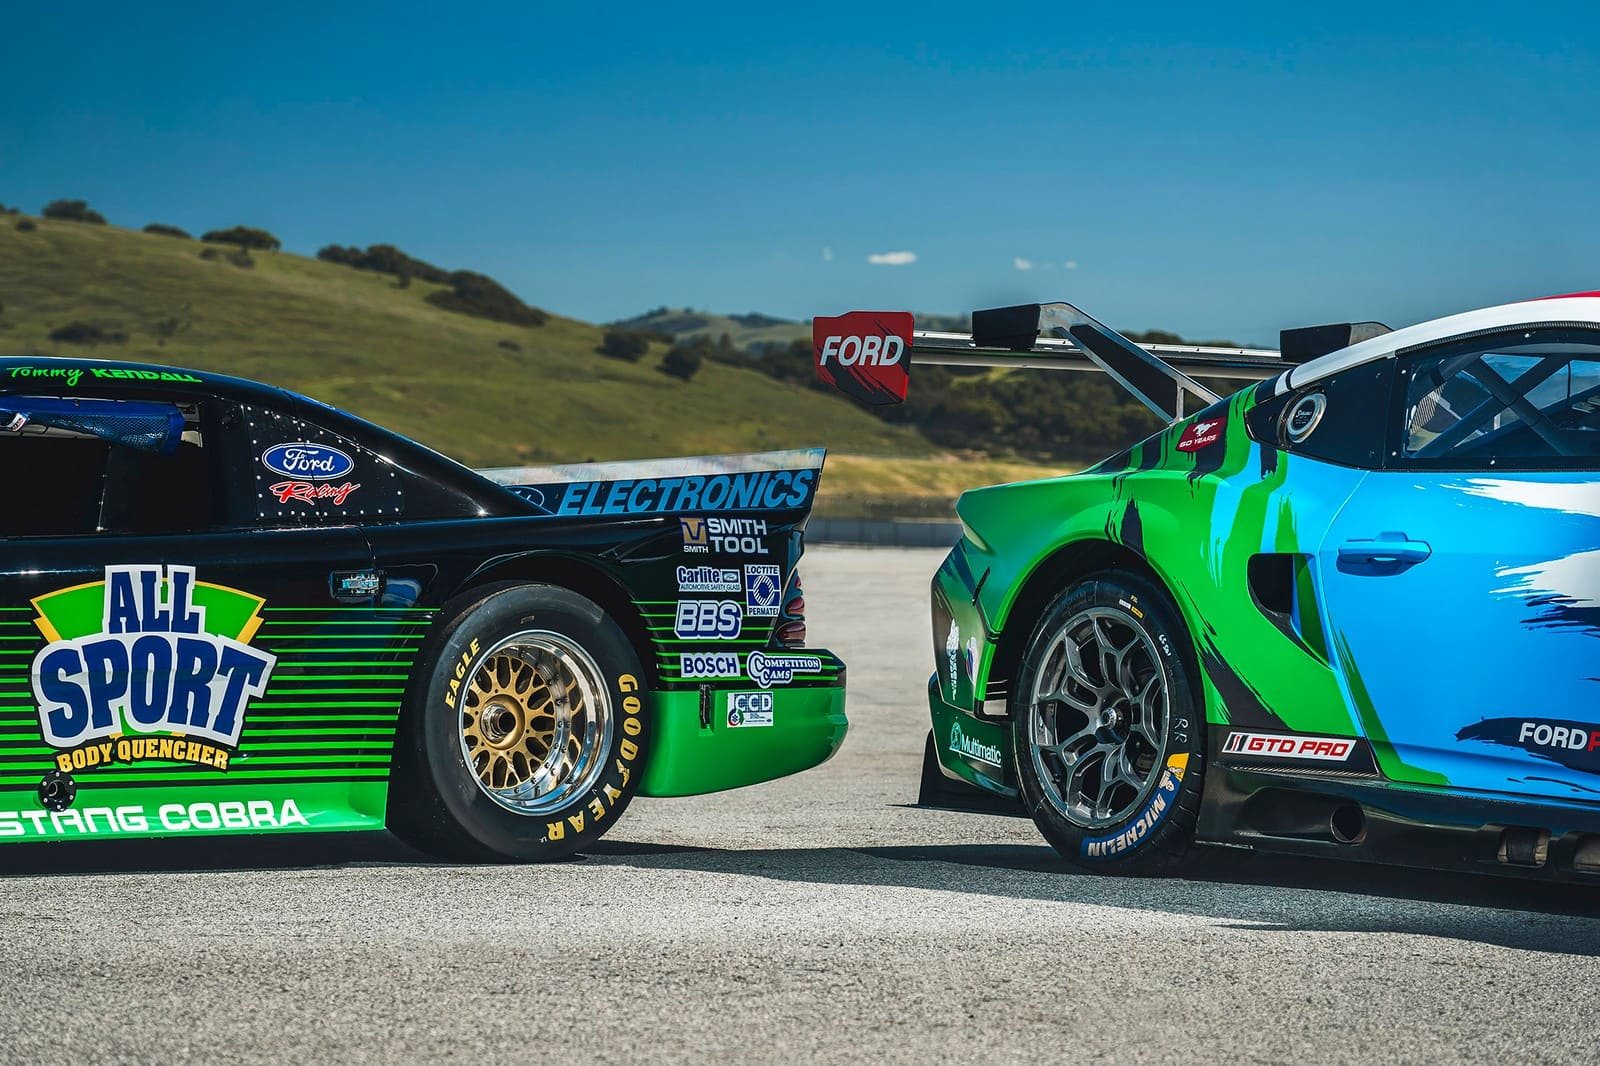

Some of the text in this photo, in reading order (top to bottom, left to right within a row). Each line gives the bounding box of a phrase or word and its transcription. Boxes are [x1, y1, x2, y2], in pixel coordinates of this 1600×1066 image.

[819, 335, 905, 367] FORD
[6, 366, 203, 387] Tommy KENDALL
[1179, 434, 1217, 448] 60 YEARS
[282, 447, 336, 472] Ford
[269, 481, 361, 506] Racing
[556, 469, 814, 516] ELECTRONICS
[707, 518, 768, 536] SMITH
[683, 545, 709, 553] SMITH
[709, 536, 769, 554] TOOL
[677, 566, 720, 583] Carlite
[746, 565, 778, 575] LOCTITE
[106, 568, 203, 637] ALL
[676, 601, 740, 636] BBS
[444, 637, 481, 710] EAGLE
[683, 656, 738, 674] BOSCH
[748, 652, 820, 679] COMPETITION
[37, 632, 270, 742] SPORT
[762, 669, 791, 687] CAMS
[735, 693, 772, 712] CCD
[57, 738, 229, 773] BODY QUENCHER
[961, 733, 1002, 763] Multimatic
[1247, 737, 1350, 757] GTD PRO
[159, 799, 312, 831] COBRA
[1087, 793, 1167, 857] MICHELIN
